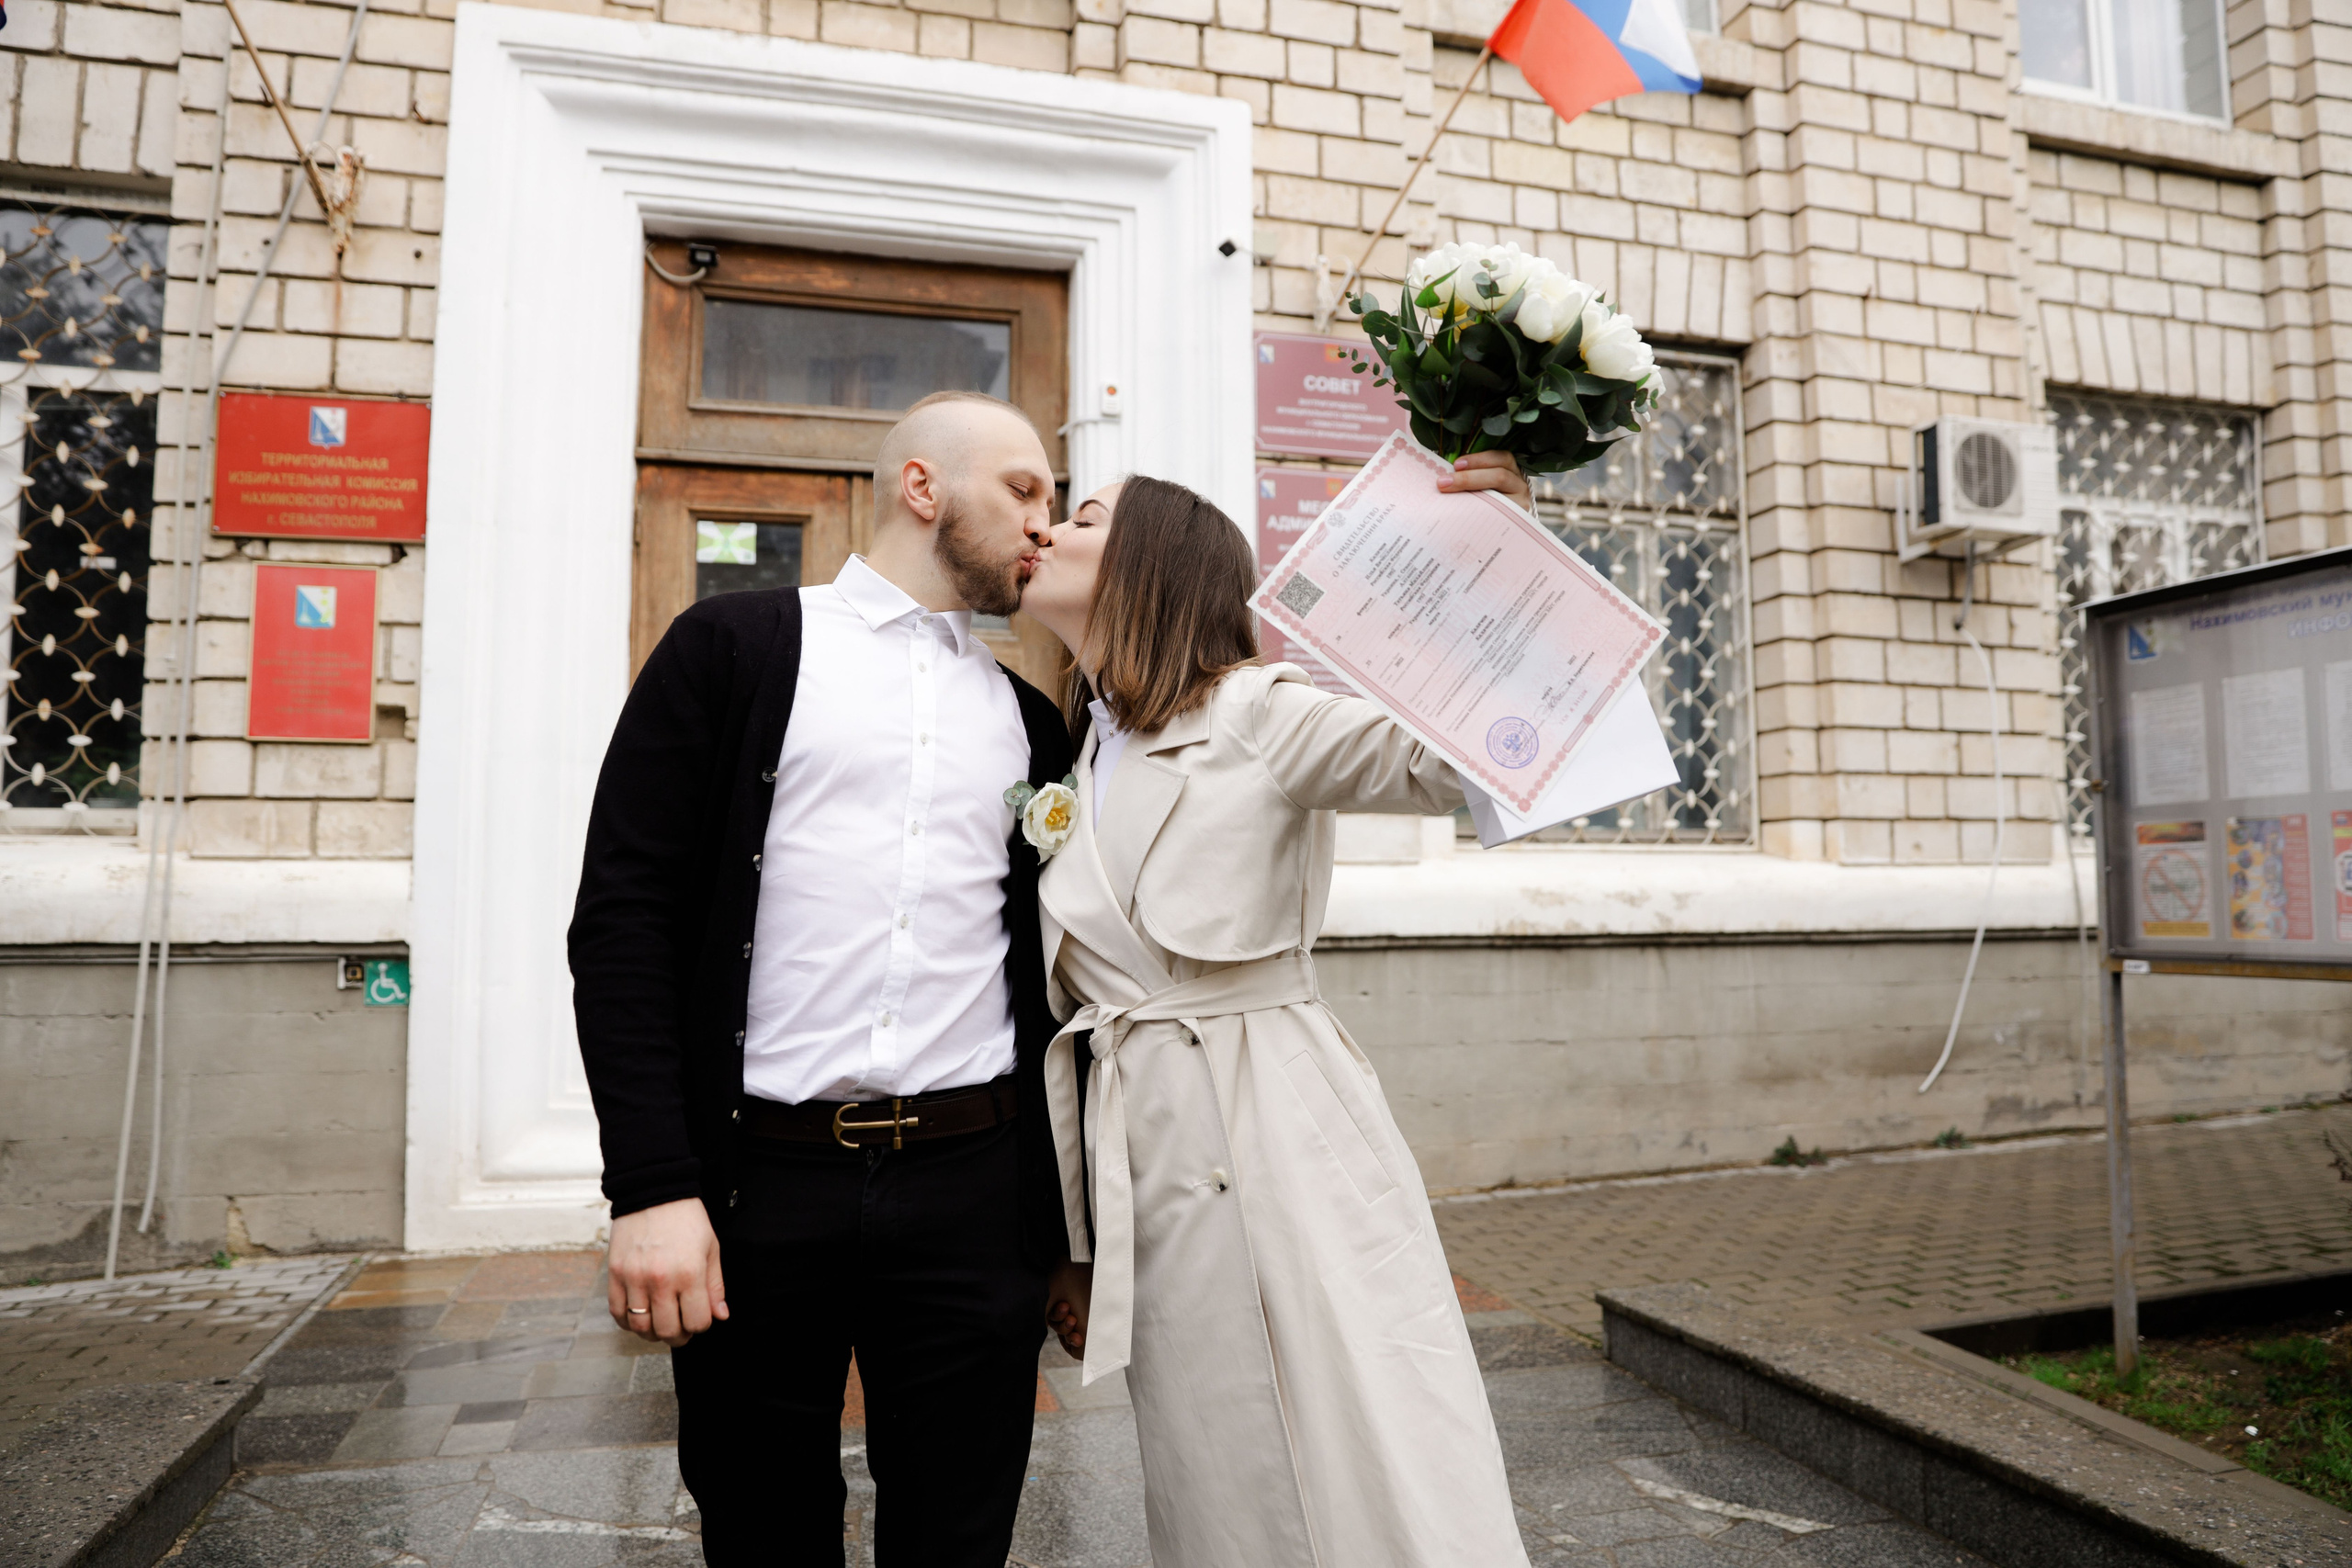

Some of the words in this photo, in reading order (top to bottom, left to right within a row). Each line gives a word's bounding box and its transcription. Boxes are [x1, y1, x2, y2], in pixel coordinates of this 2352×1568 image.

[1304, 375, 1362, 395] СОВЕТ
[261, 451, 389, 471] ТЕРРИТОРИАЛЬНАЯ
[229, 470, 341, 489] ИЗБИРАТЕЛЬНАЯ
[346, 476, 418, 492] КОМИССИЯ
[241, 491, 348, 507] НАХИМОВСКОГО
[351, 494, 404, 511] РАЙОНА
[279, 512, 377, 529] СЕВАСТОПОЛЯ
[1331, 570, 1340, 578] О
[1337, 522, 1378, 570] ЗАКЛЮЧЕНИИ
[1375, 501, 1396, 524] БРАКА
[1332, 505, 1379, 561] СВИДЕТЕЛЬСТВО
[2190, 596, 2312, 631] Нахимовский
